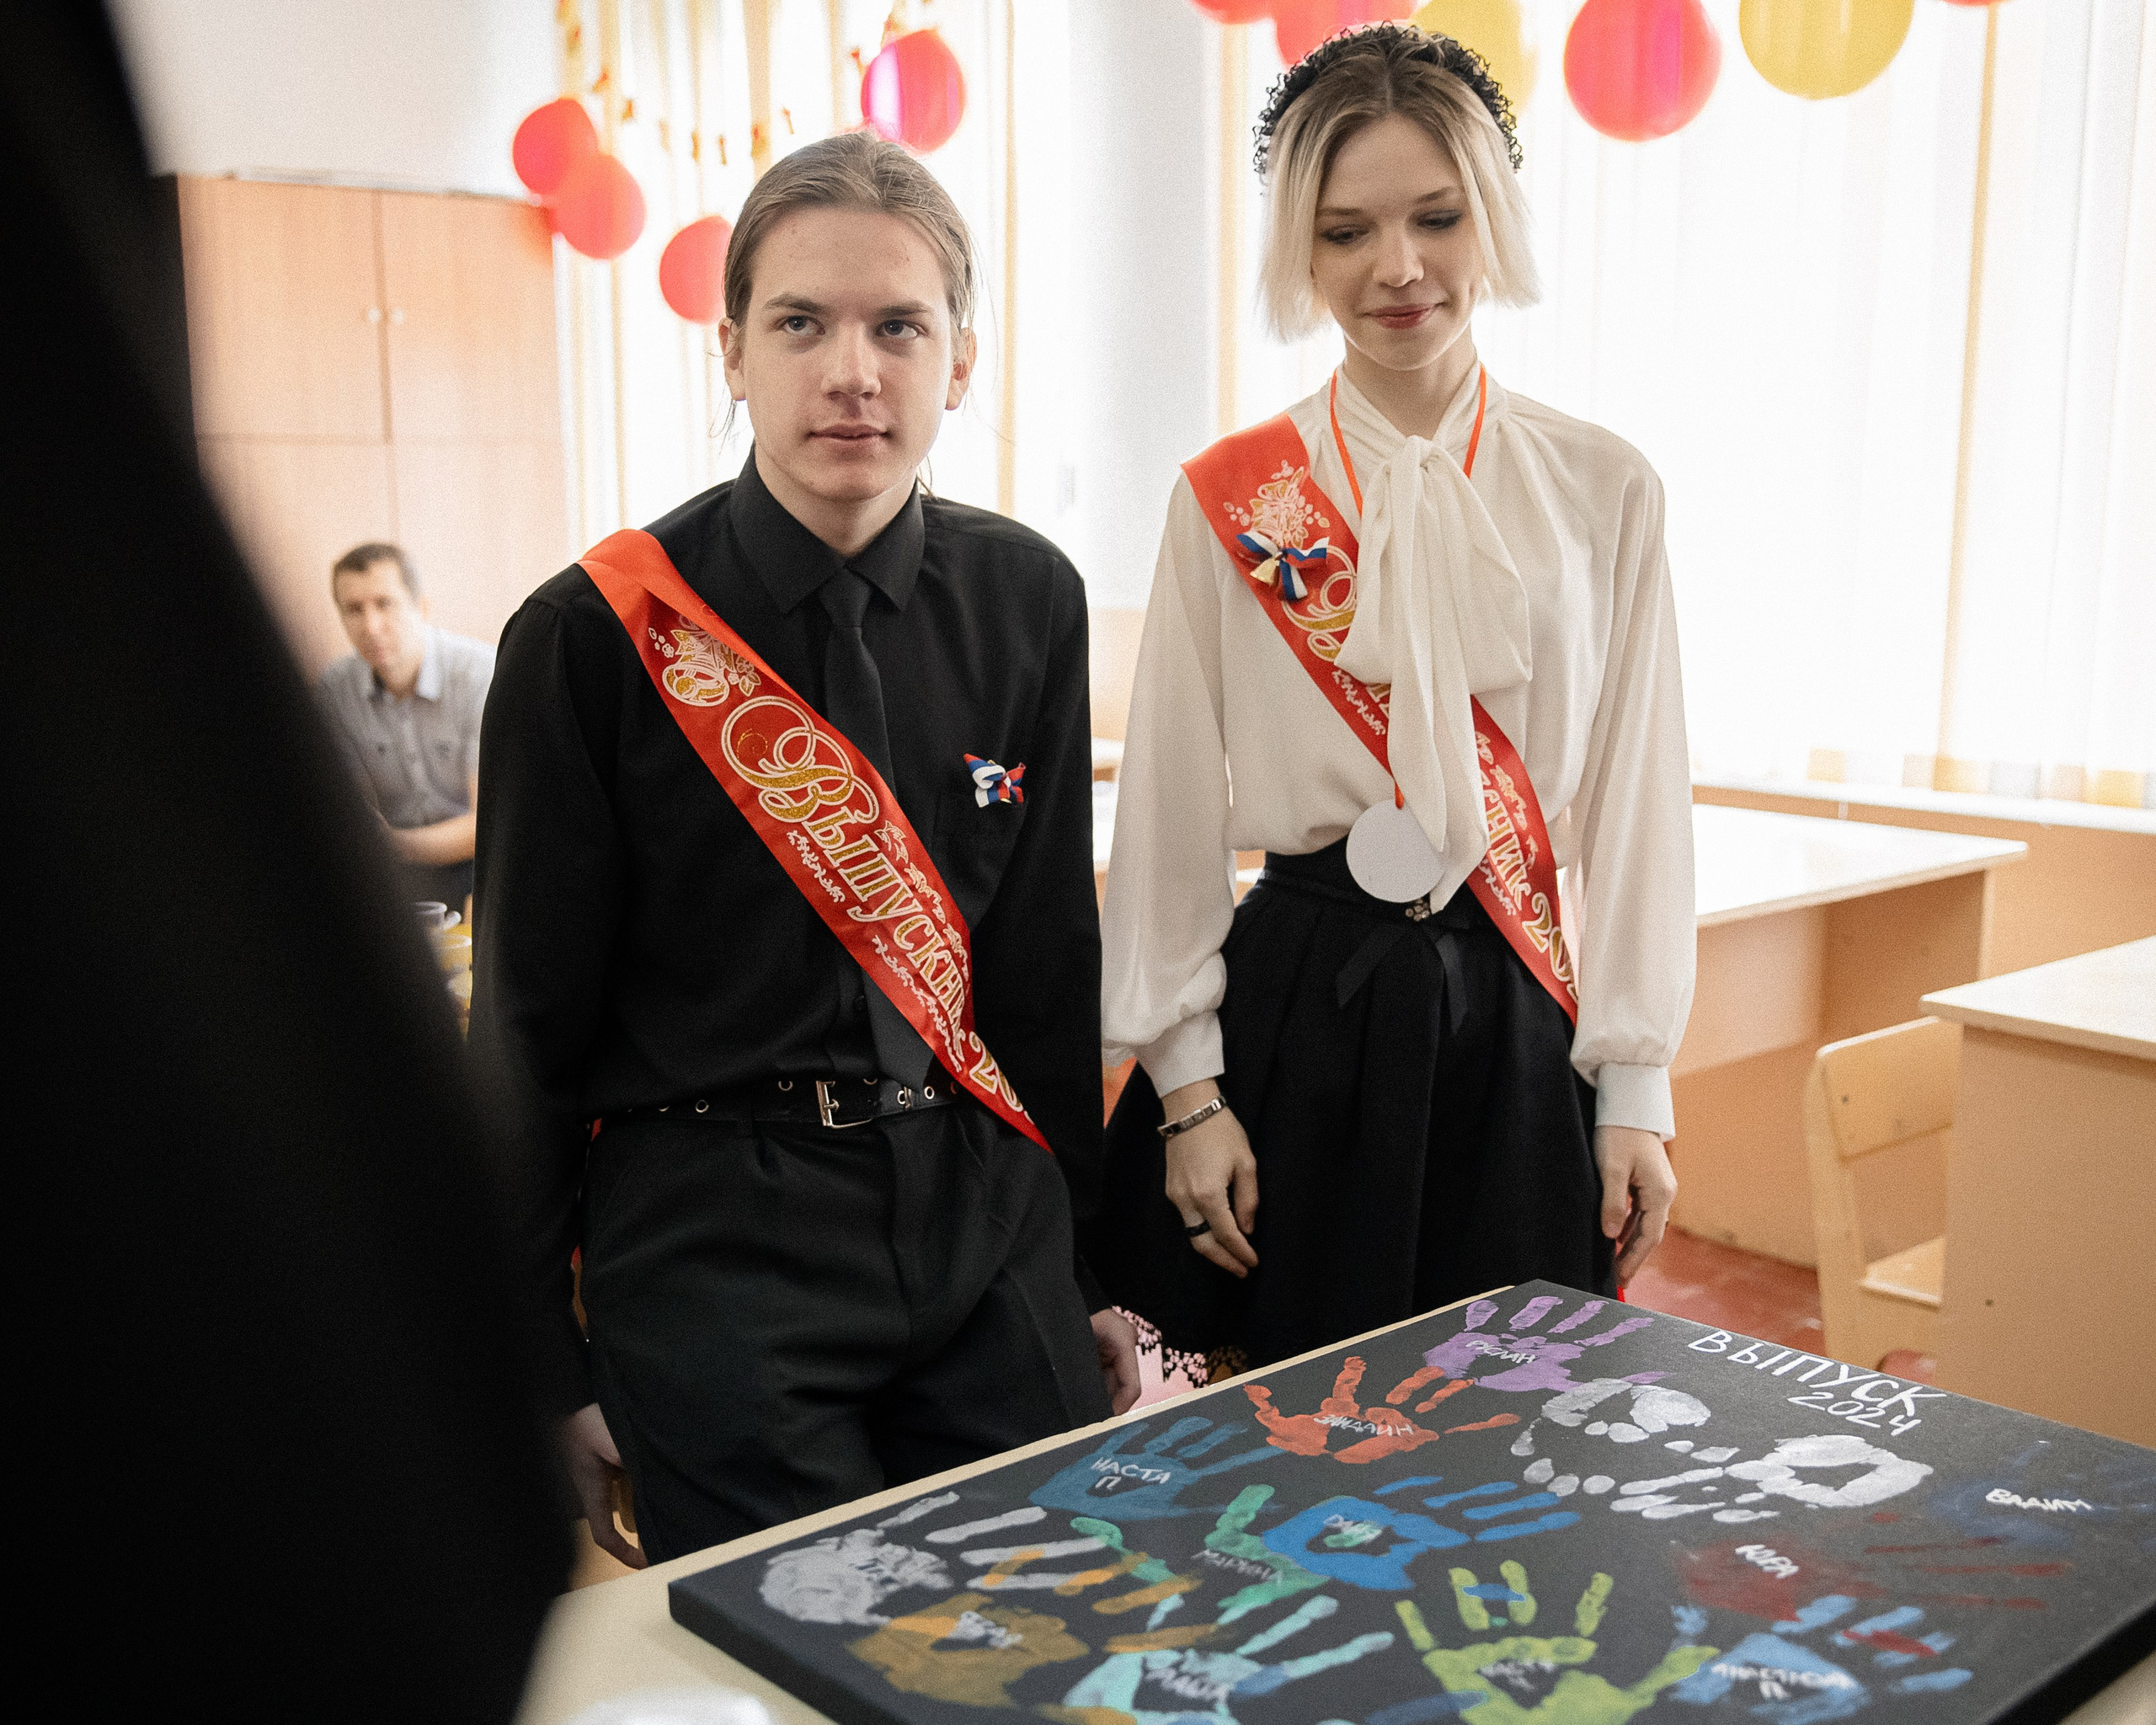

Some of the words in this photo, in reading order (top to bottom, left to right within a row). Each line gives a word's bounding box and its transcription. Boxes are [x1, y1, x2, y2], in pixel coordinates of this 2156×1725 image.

[1522, 892, 1578, 1003] 20
[969, 1031, 1034, 1124] 20
[1687, 1330, 1948, 1417] ВЫПУСК
[1787, 1391, 1922, 1435] 2024
